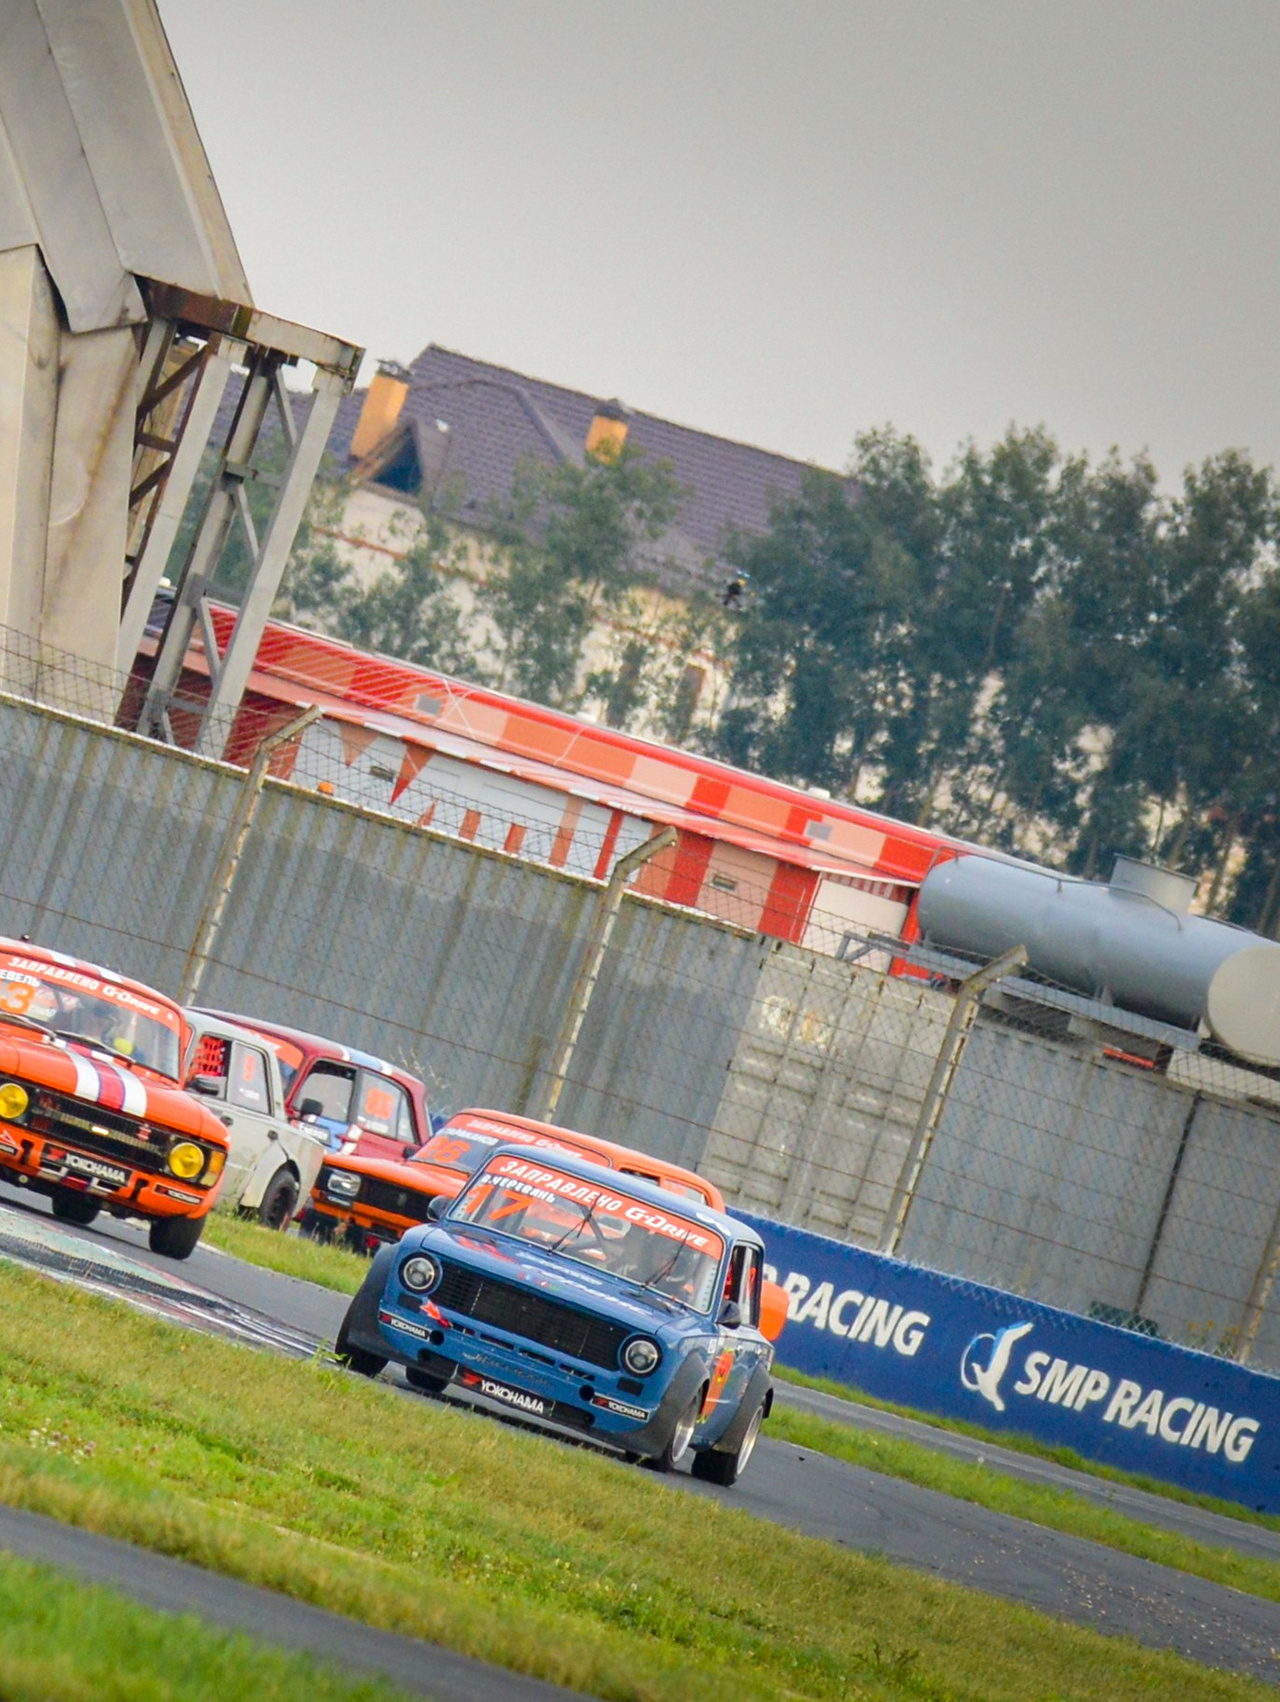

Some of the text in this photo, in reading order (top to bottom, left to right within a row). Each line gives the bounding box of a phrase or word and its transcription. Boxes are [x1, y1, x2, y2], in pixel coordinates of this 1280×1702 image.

[8, 957, 99, 991] ЗАПРАВЛЕНО
[66, 1153, 125, 1182] YOKOHAMA
[500, 1160, 622, 1212] ЗАПРАВЛЕНО
[465, 1183, 534, 1220] 17
[783, 1273, 930, 1356] RACING
[480, 1379, 544, 1414] YOKOHAMA
[1014, 1350, 1260, 1462] SMP RACING
